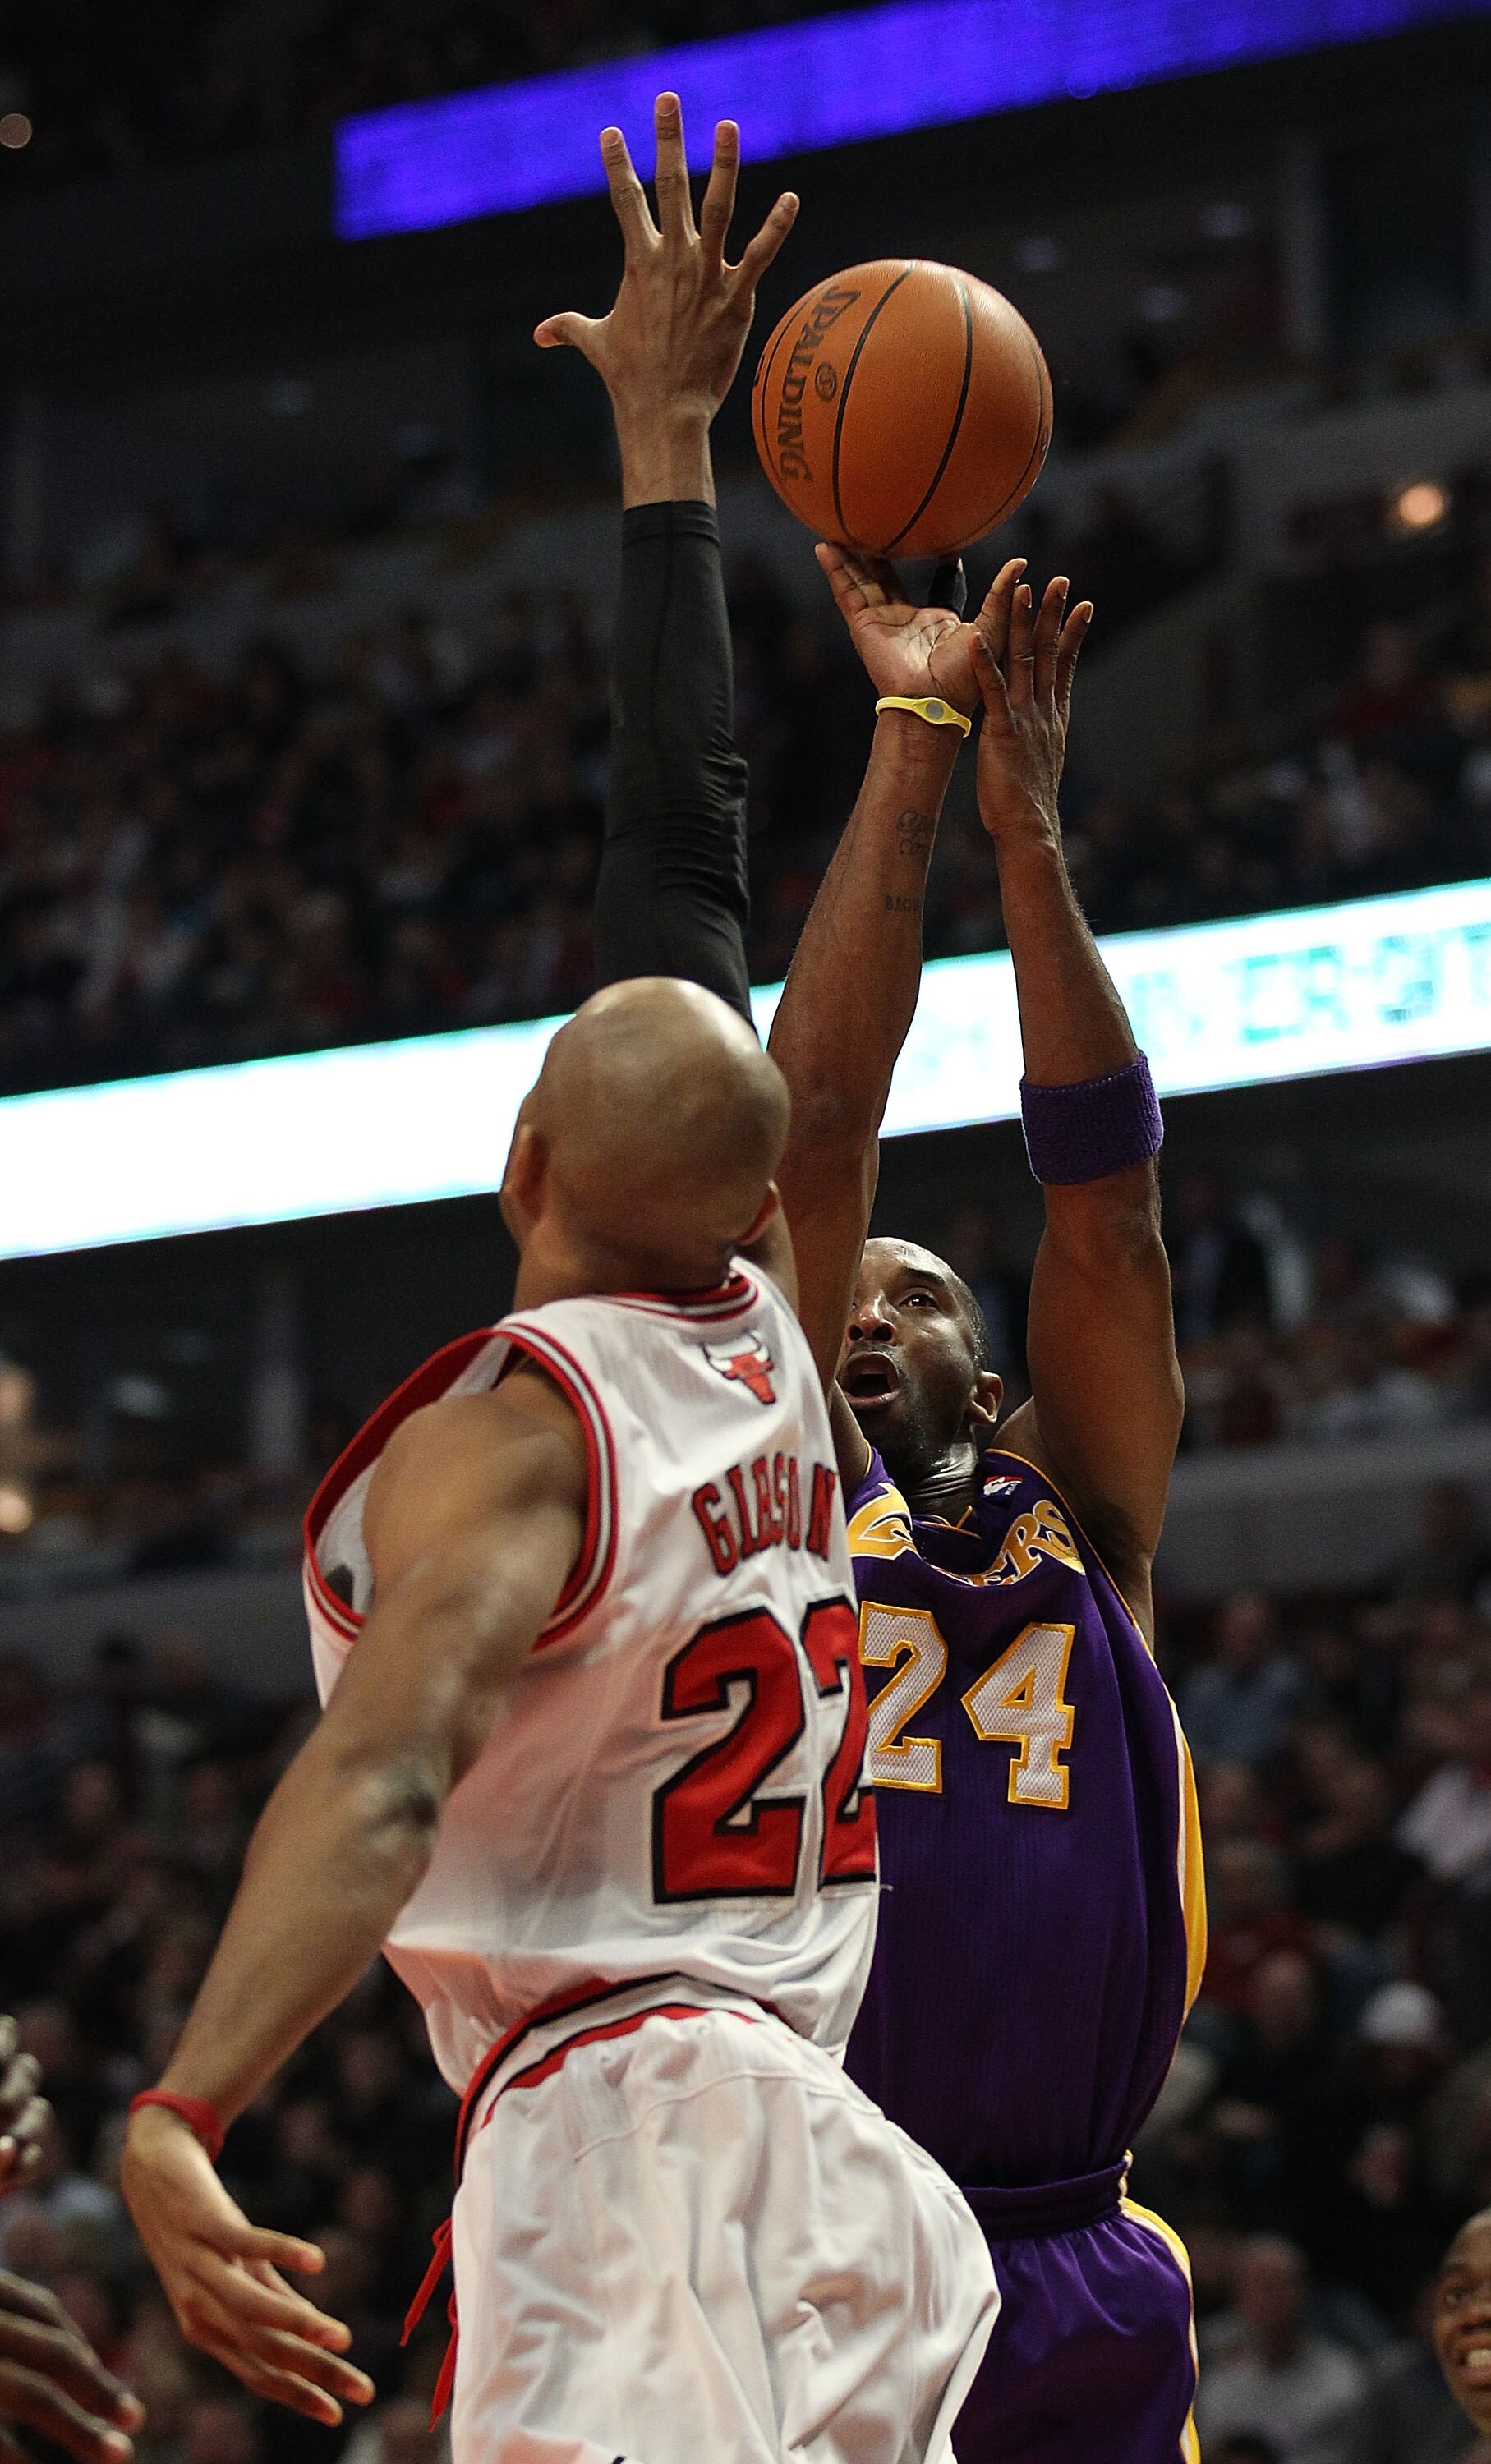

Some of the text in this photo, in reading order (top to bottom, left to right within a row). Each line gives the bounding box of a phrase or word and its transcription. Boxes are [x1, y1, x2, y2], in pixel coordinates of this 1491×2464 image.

[777, 285, 862, 483] SPALDING
[653, 1593, 877, 1905] 22
[858, 1600, 1075, 1810] 24
